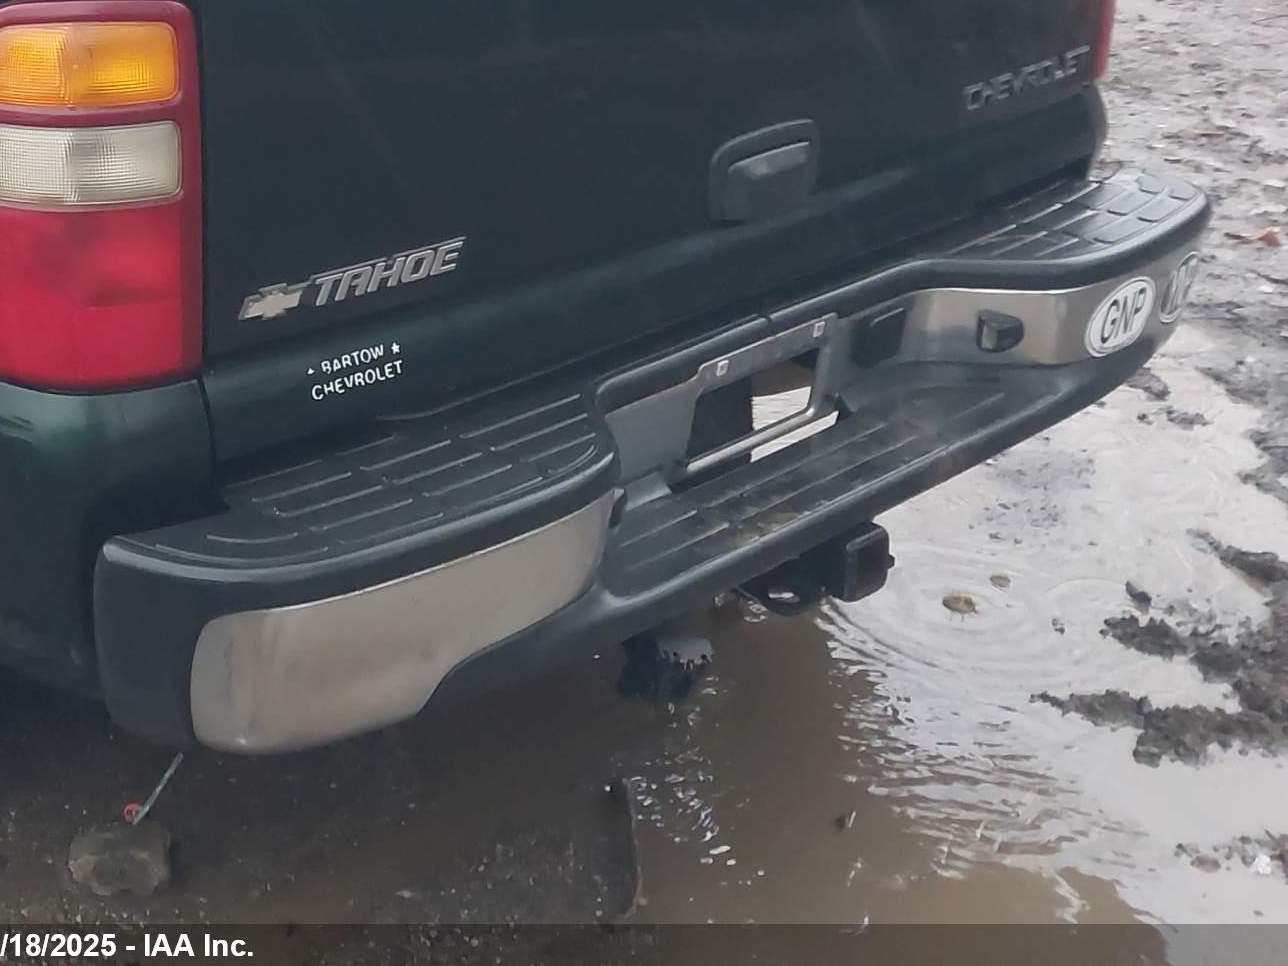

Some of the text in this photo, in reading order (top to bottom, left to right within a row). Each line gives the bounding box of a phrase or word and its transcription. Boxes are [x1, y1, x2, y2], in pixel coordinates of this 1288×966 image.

[315, 240, 464, 306] TAHOE
[1100, 287, 1147, 345] GNP
[311, 360, 403, 401] CHEVROLET
[320, 344, 385, 375] BARTOW
